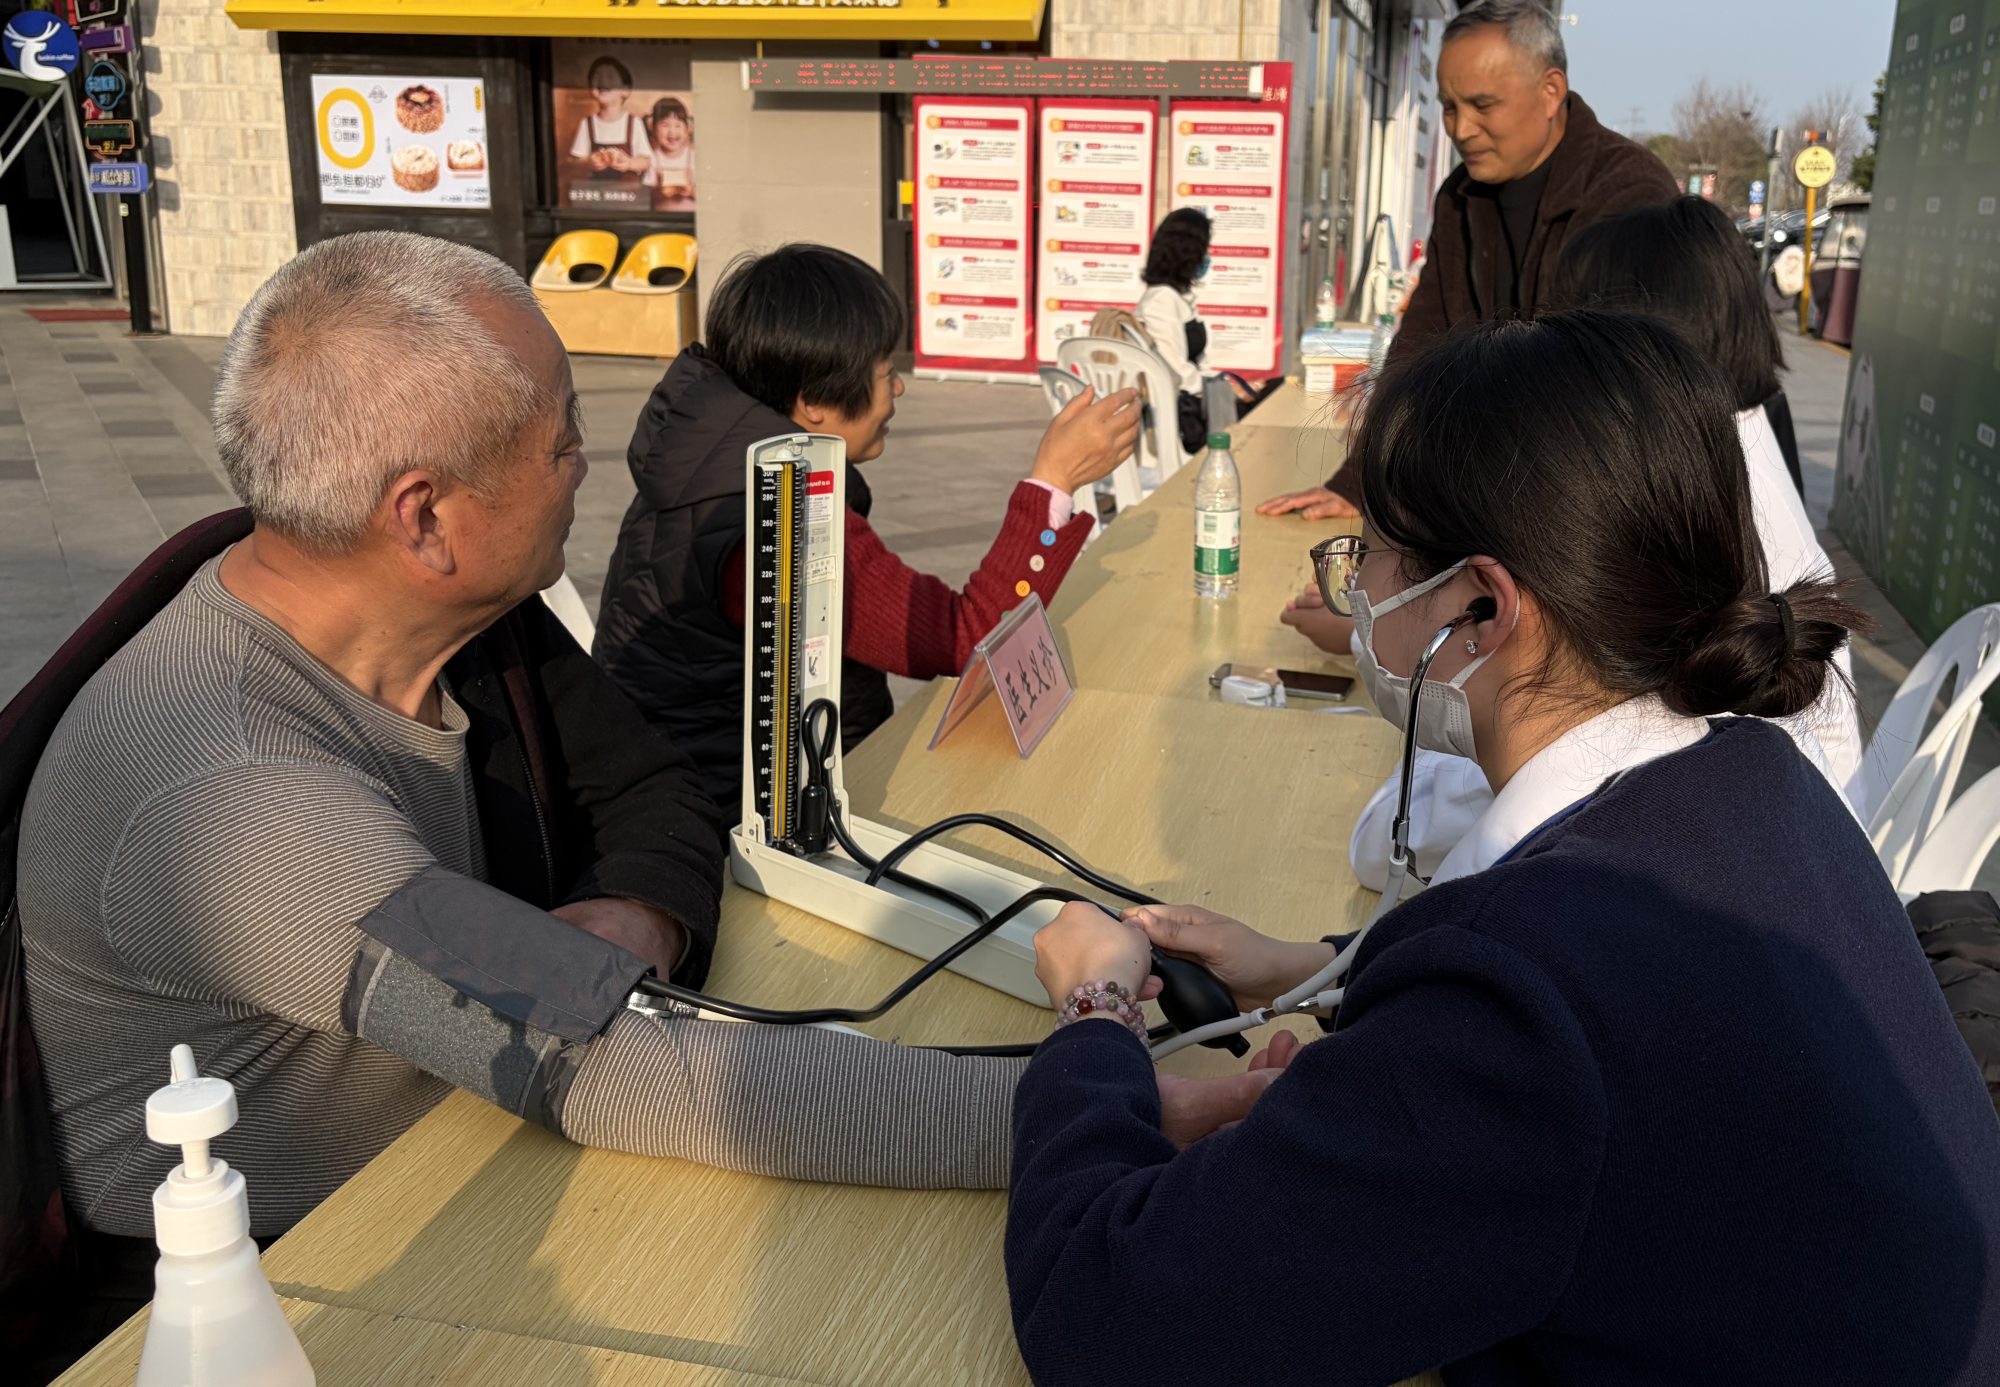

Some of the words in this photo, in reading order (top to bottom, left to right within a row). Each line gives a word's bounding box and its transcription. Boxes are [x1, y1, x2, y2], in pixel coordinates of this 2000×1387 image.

[762, 519, 774, 527] 260
[761, 570, 773, 578] 220
[759, 719, 769, 727] 100
[760, 791, 768, 799] 40
